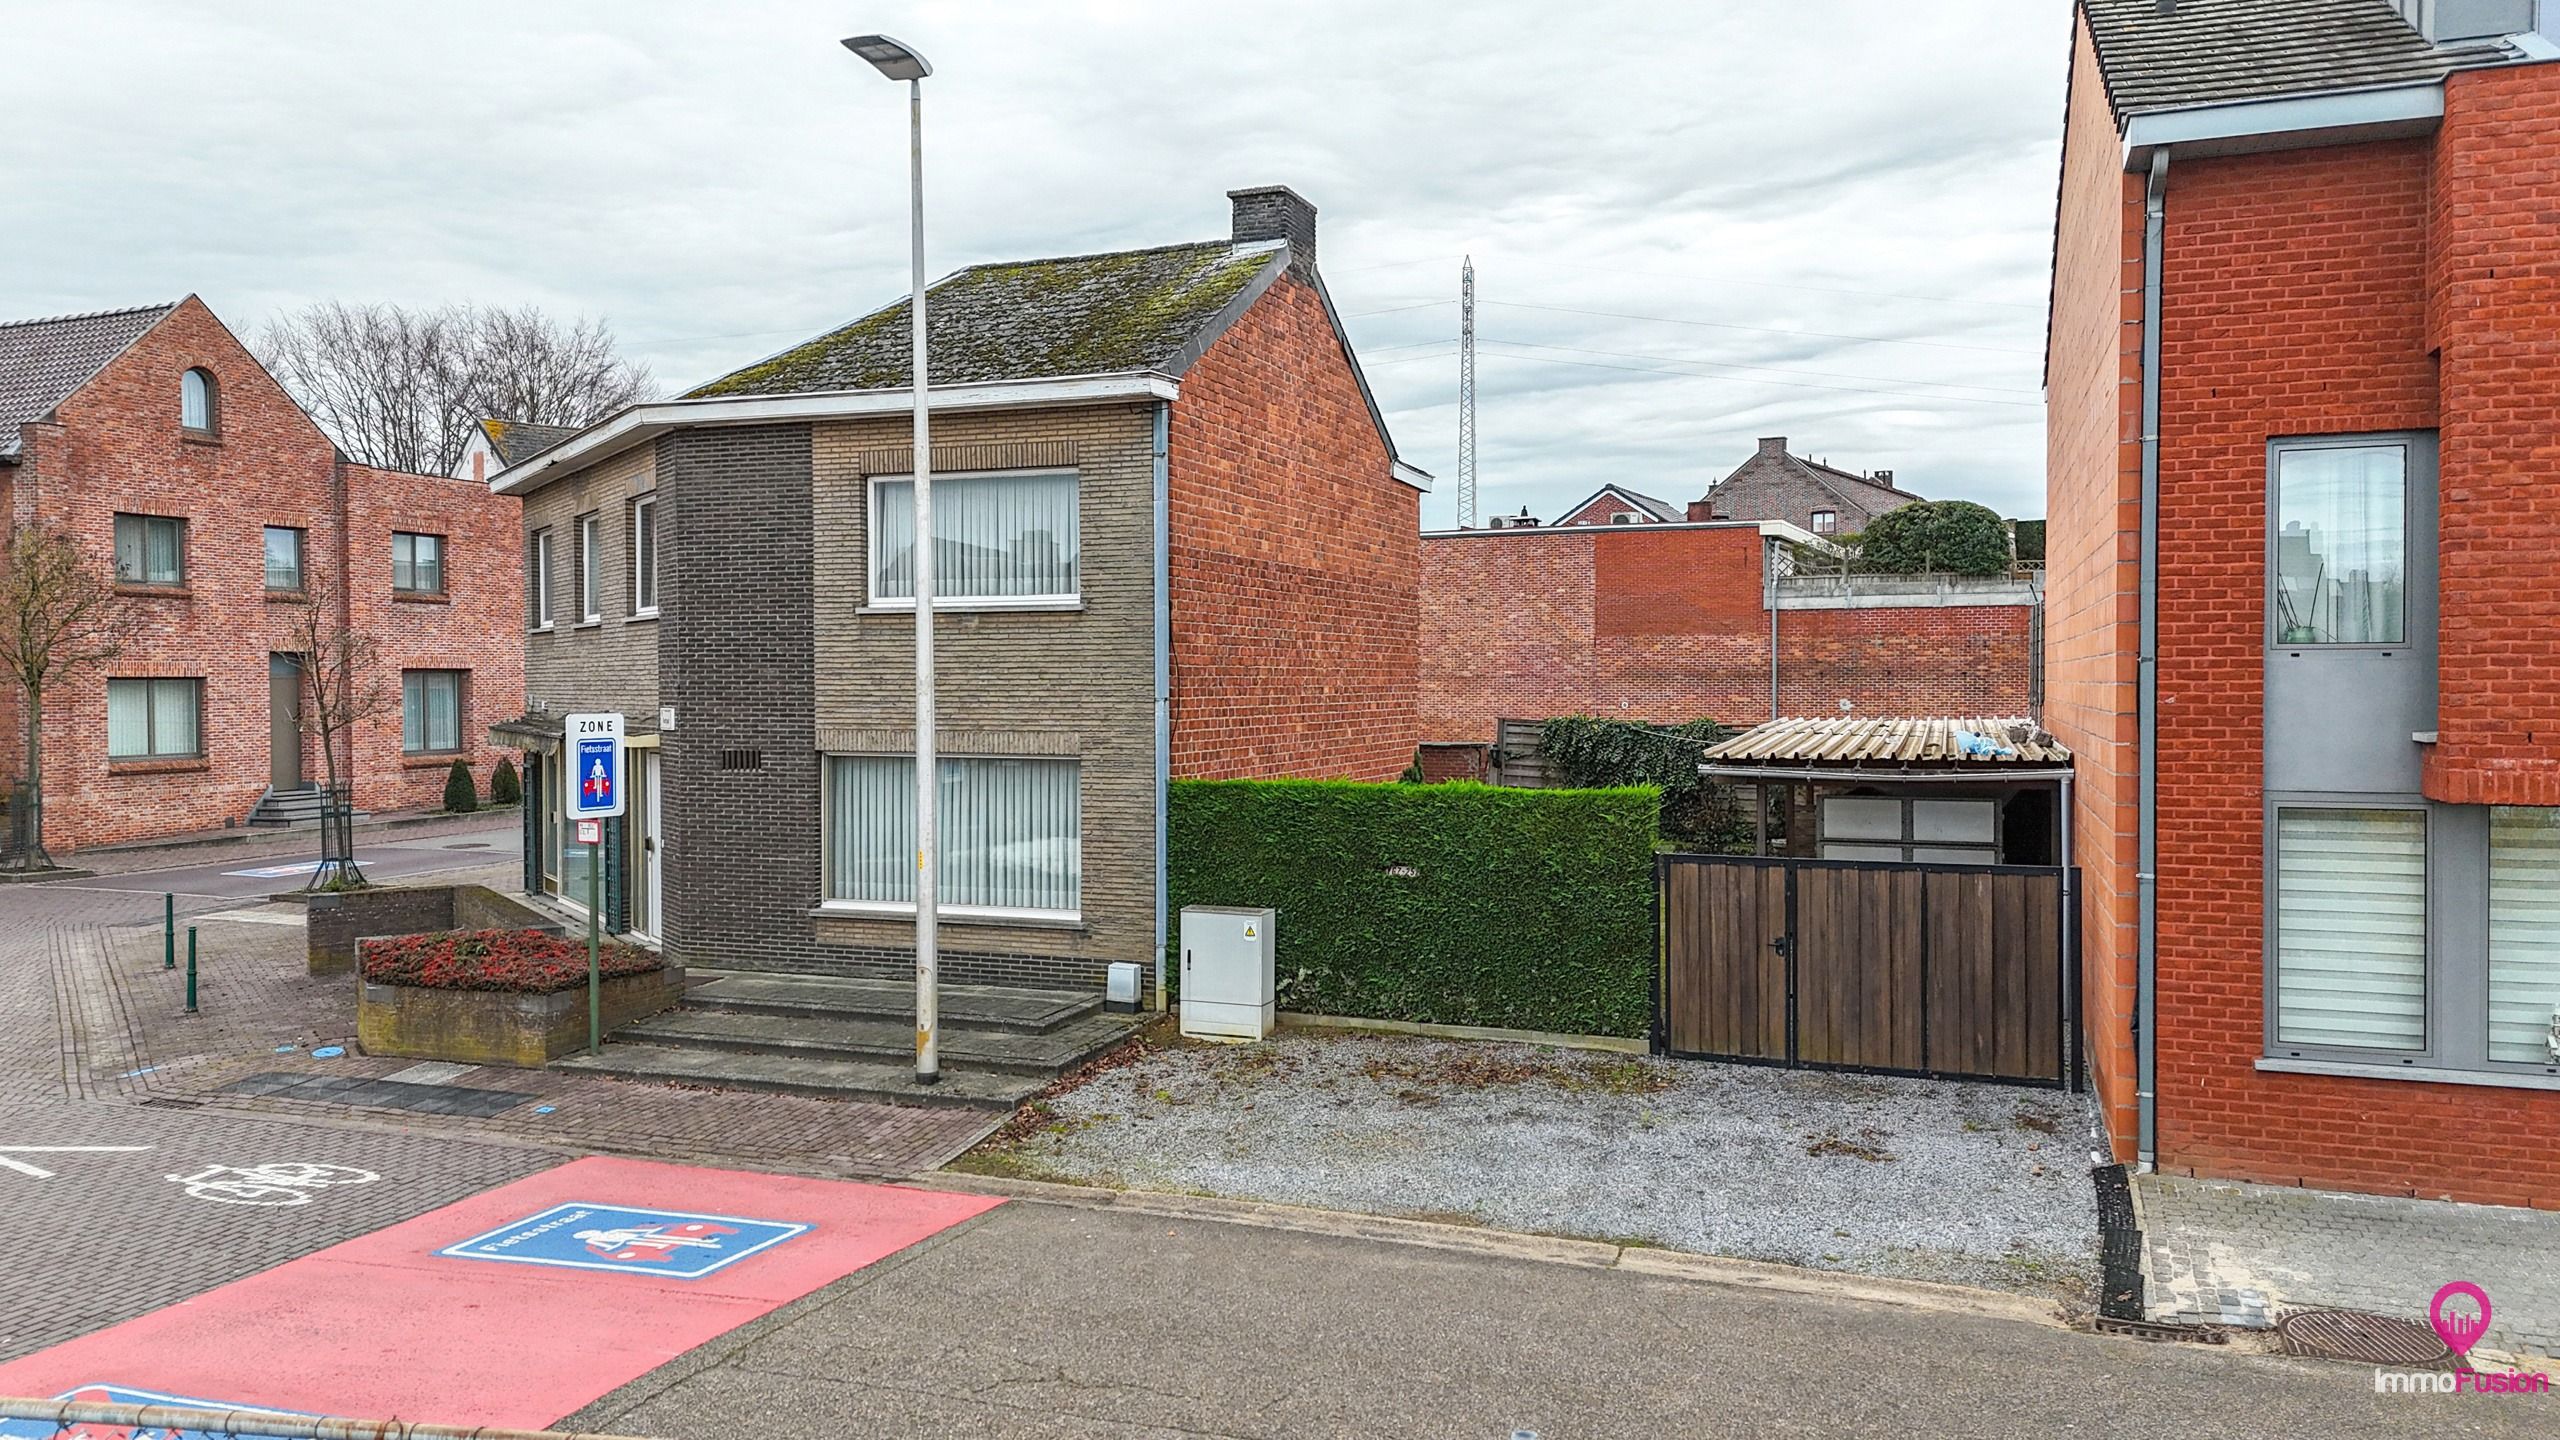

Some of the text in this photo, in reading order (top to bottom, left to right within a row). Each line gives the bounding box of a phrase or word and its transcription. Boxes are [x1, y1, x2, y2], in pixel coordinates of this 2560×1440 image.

[580, 720, 613, 733] ZONE
[580, 744, 612, 754] Fietsstraat
[479, 1210, 594, 1252] Fietsstraat
